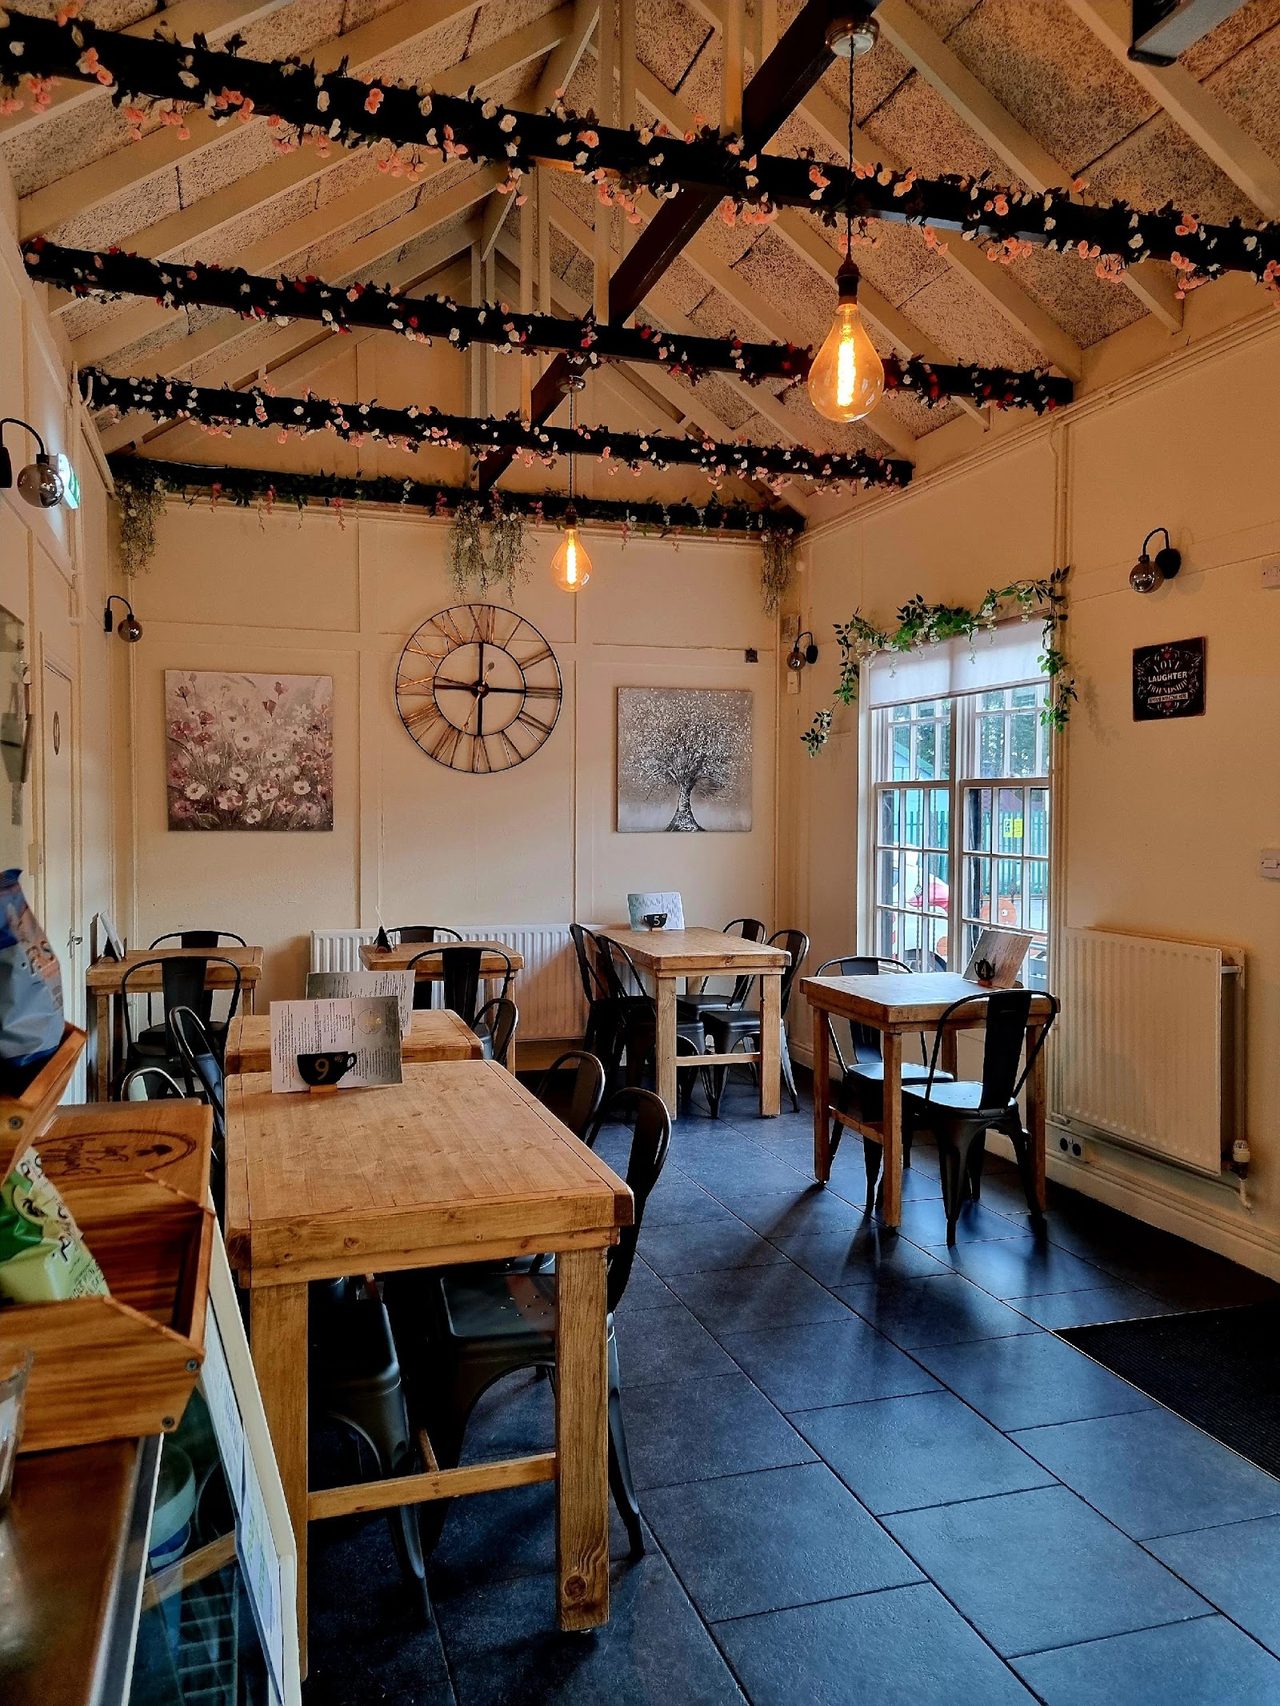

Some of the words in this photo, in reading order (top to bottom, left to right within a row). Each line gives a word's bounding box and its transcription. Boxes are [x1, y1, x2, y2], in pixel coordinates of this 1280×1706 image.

[1148, 671, 1188, 683] LAUGHTER
[653, 915, 661, 926] 5
[980, 962, 987, 978] 4
[315, 1058, 330, 1080] 9
